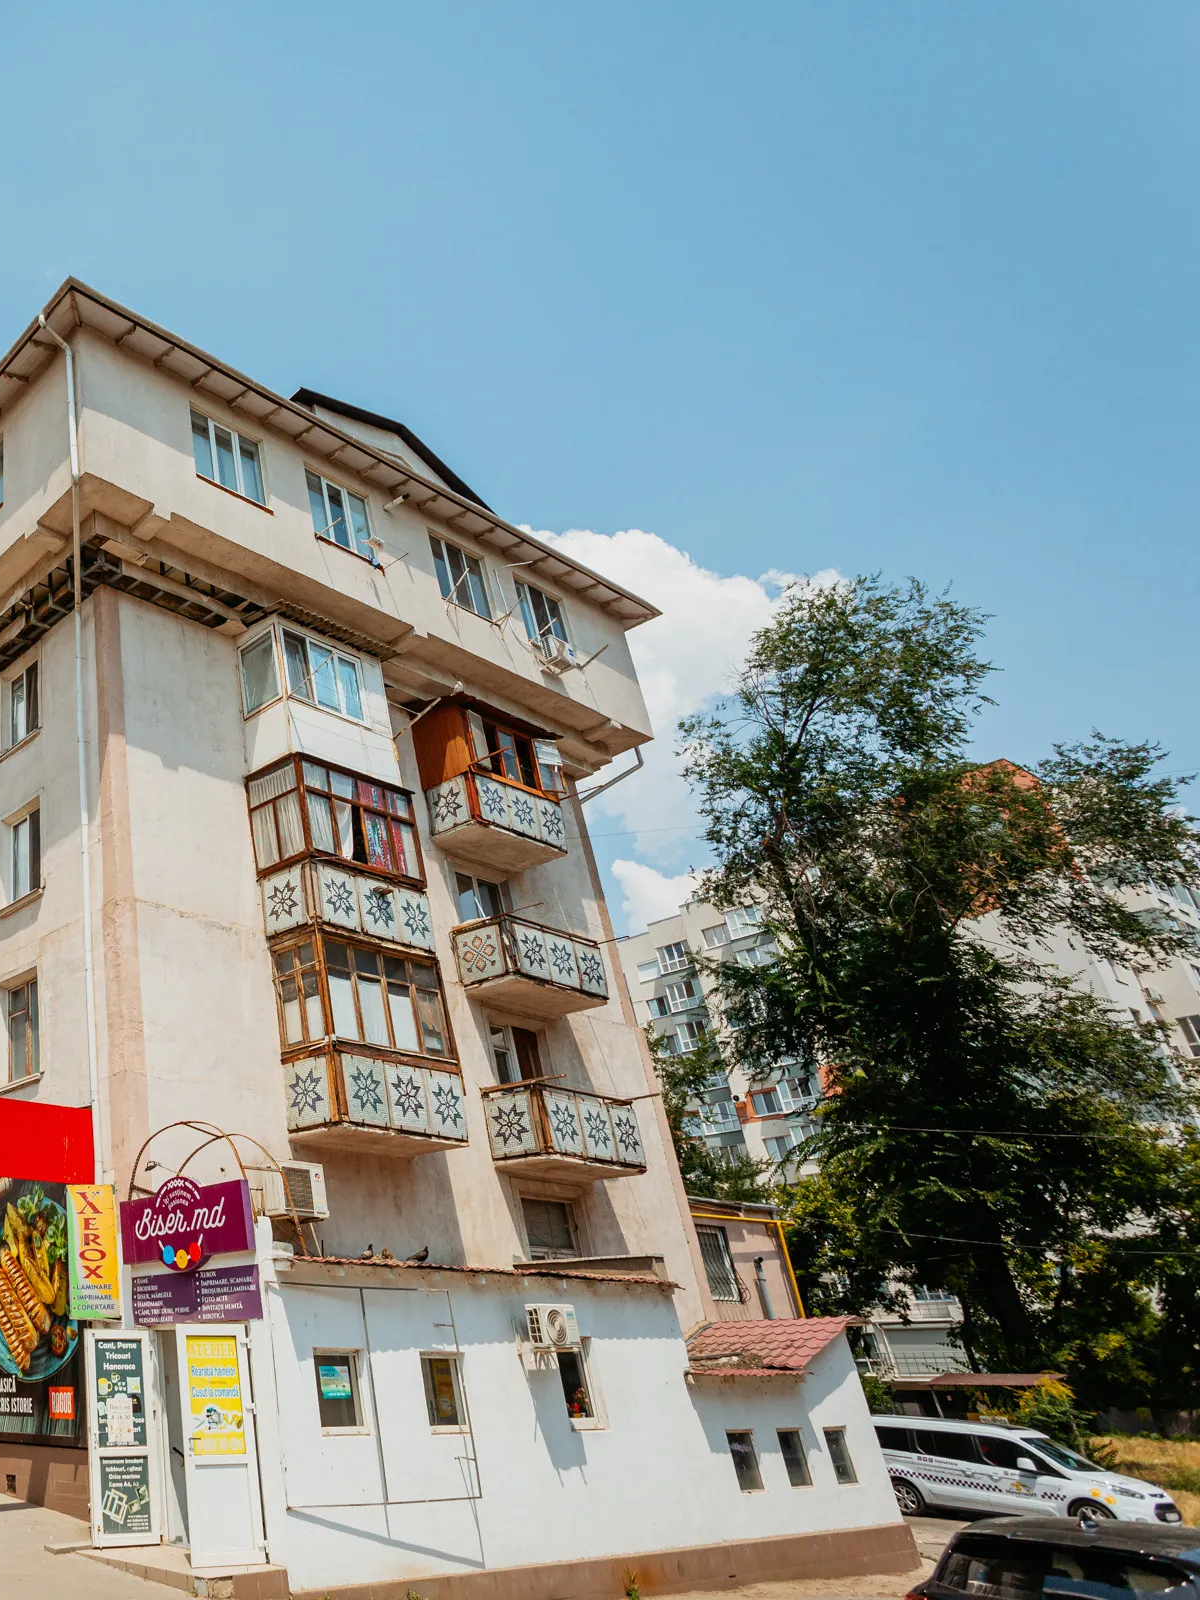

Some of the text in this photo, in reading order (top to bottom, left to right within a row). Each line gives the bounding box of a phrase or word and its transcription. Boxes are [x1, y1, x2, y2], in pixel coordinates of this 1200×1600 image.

[135, 1197, 226, 1240] Biser.md
[76, 1191, 107, 1279] XEROX
[98, 1341, 137, 1349] Cani, Perne
[188, 1342, 236, 1358] ATELIER
[105, 1352, 131, 1360] Tricouri
[103, 1362, 136, 1370] Hanorace
[191, 1386, 208, 1398] Cusut
[214, 1385, 239, 1398] comandă
[11, 1398, 33, 1414] ISTORIE
[51, 1392, 72, 1414] ROGOB
